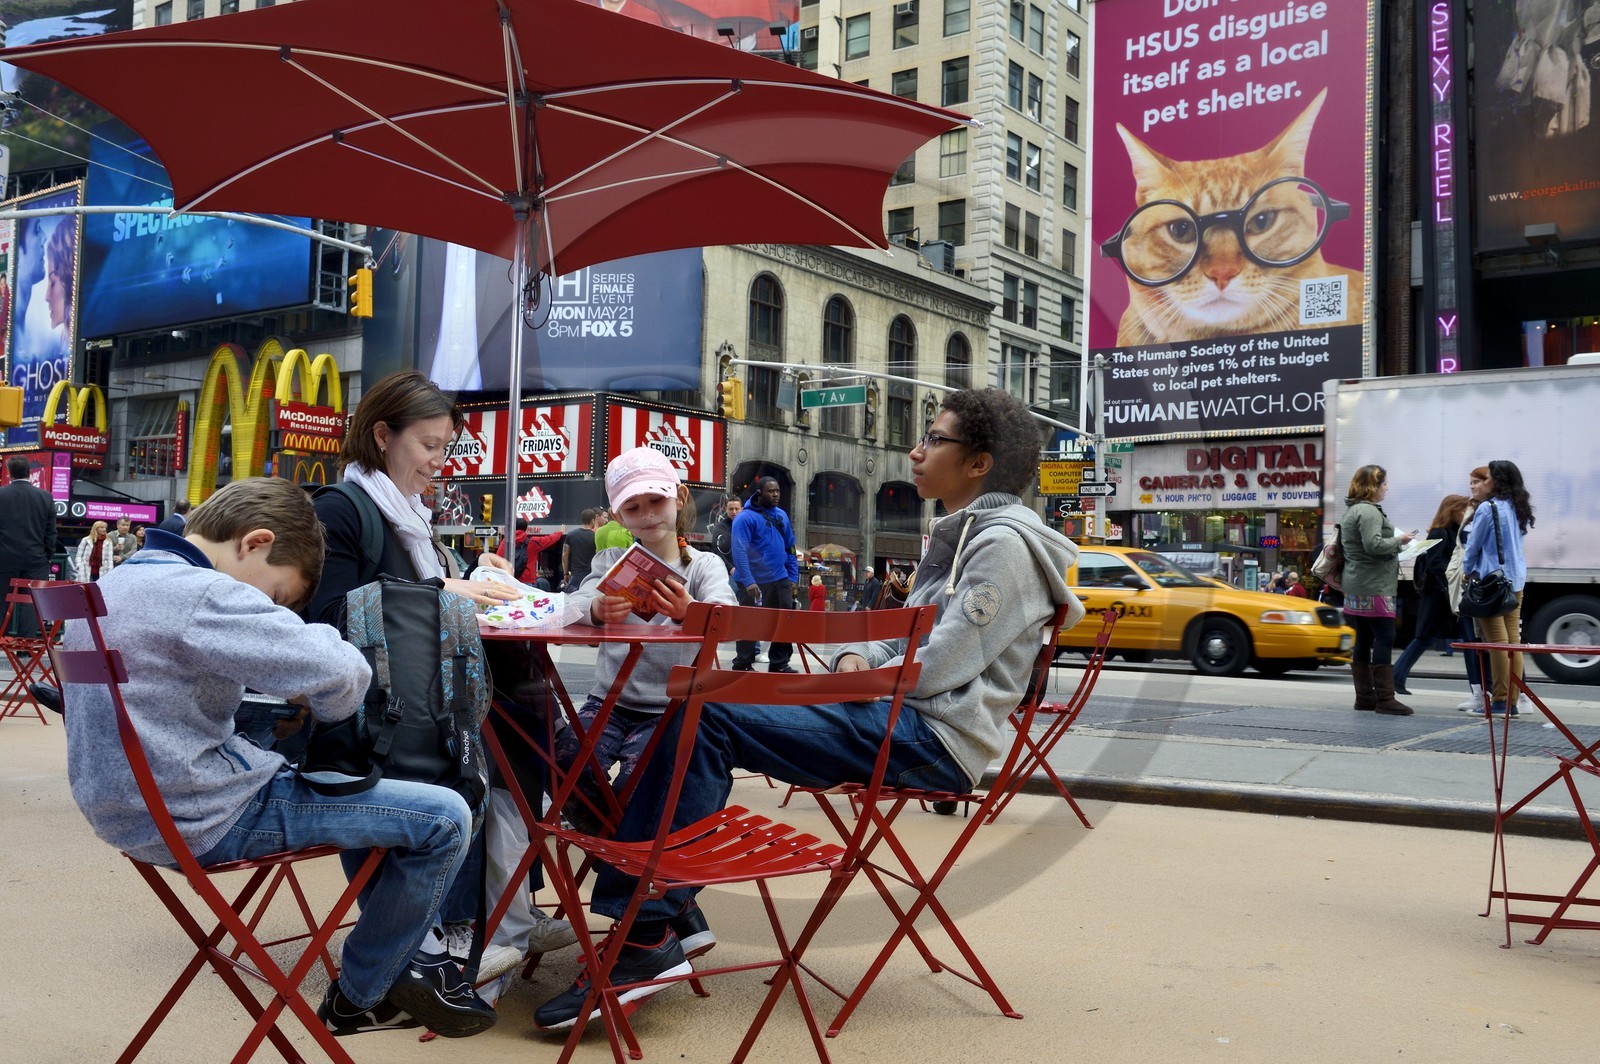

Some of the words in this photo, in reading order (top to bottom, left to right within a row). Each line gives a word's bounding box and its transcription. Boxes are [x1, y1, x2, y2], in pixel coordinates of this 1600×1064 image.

[1126, 23, 1199, 60] HSUS
[1209, 1, 1328, 41] disguise
[1431, 3, 1450, 102] SEXY
[1123, 59, 1190, 95] itself
[1197, 59, 1226, 80] as
[1235, 54, 1251, 72] a
[1261, 29, 1328, 67] local
[1143, 99, 1189, 133] pet
[1197, 81, 1302, 116] shelter.
[1434, 124, 1452, 222] REEL
[592, 273, 635, 284] SERIES
[763, 244, 791, 262] SHOE
[795, 251, 821, 270] SHOP
[824, 260, 874, 288] DEDICATED
[878, 278, 890, 294] TO
[930, 296, 939, 310] IN
[943, 301, 986, 325] FOOTWEAR
[592, 283, 634, 294] FINALE
[592, 294, 634, 304] EVENT
[549, 306, 586, 320] MON
[587, 306, 618, 319] MAY
[618, 306, 634, 319] 21
[548, 320, 579, 337] 8PM
[581, 320, 617, 337] FOX
[620, 320, 633, 337] 5
[1112, 351, 1134, 363] The
[1137, 350, 1187, 361] Humane
[1190, 343, 1236, 357] Society
[1240, 339, 1254, 352] of
[1257, 338, 1279, 350] the
[1283, 333, 1329, 348] United
[12, 357, 69, 391] GHOST
[1112, 368, 1149, 379] States
[1152, 363, 1178, 377] only
[1182, 362, 1214, 376] gives
[1218, 358, 1238, 370] 1%
[1242, 355, 1256, 368] of
[1259, 355, 1275, 366] its
[1280, 351, 1329, 367] budget
[1152, 382, 1166, 391] to
[1169, 377, 1197, 390] local
[1201, 376, 1222, 391] pet
[1226, 372, 1281, 385] shelters.
[819, 393, 826, 403] 7
[830, 392, 845, 402] Av
[280, 409, 343, 427] McDonald's
[290, 421, 332, 433] Restaurant
[45, 430, 107, 445] McDonald's
[55, 440, 96, 450] Restaurant
[1115, 444, 1120, 452] 7
[1186, 443, 1322, 471] DIGITAL
[1139, 474, 1225, 490] CAMERAS
[1234, 473, 1248, 488] &
[1258, 471, 1321, 487] COMPU
[1165, 493, 1184, 502] HOUR
[1188, 493, 1212, 502] PHOTO
[1222, 492, 1257, 501] LUGGAGE
[1267, 491, 1278, 500] NY
[1282, 491, 1321, 500] SOUVENIR
[462, 730, 470, 764] Quechua
